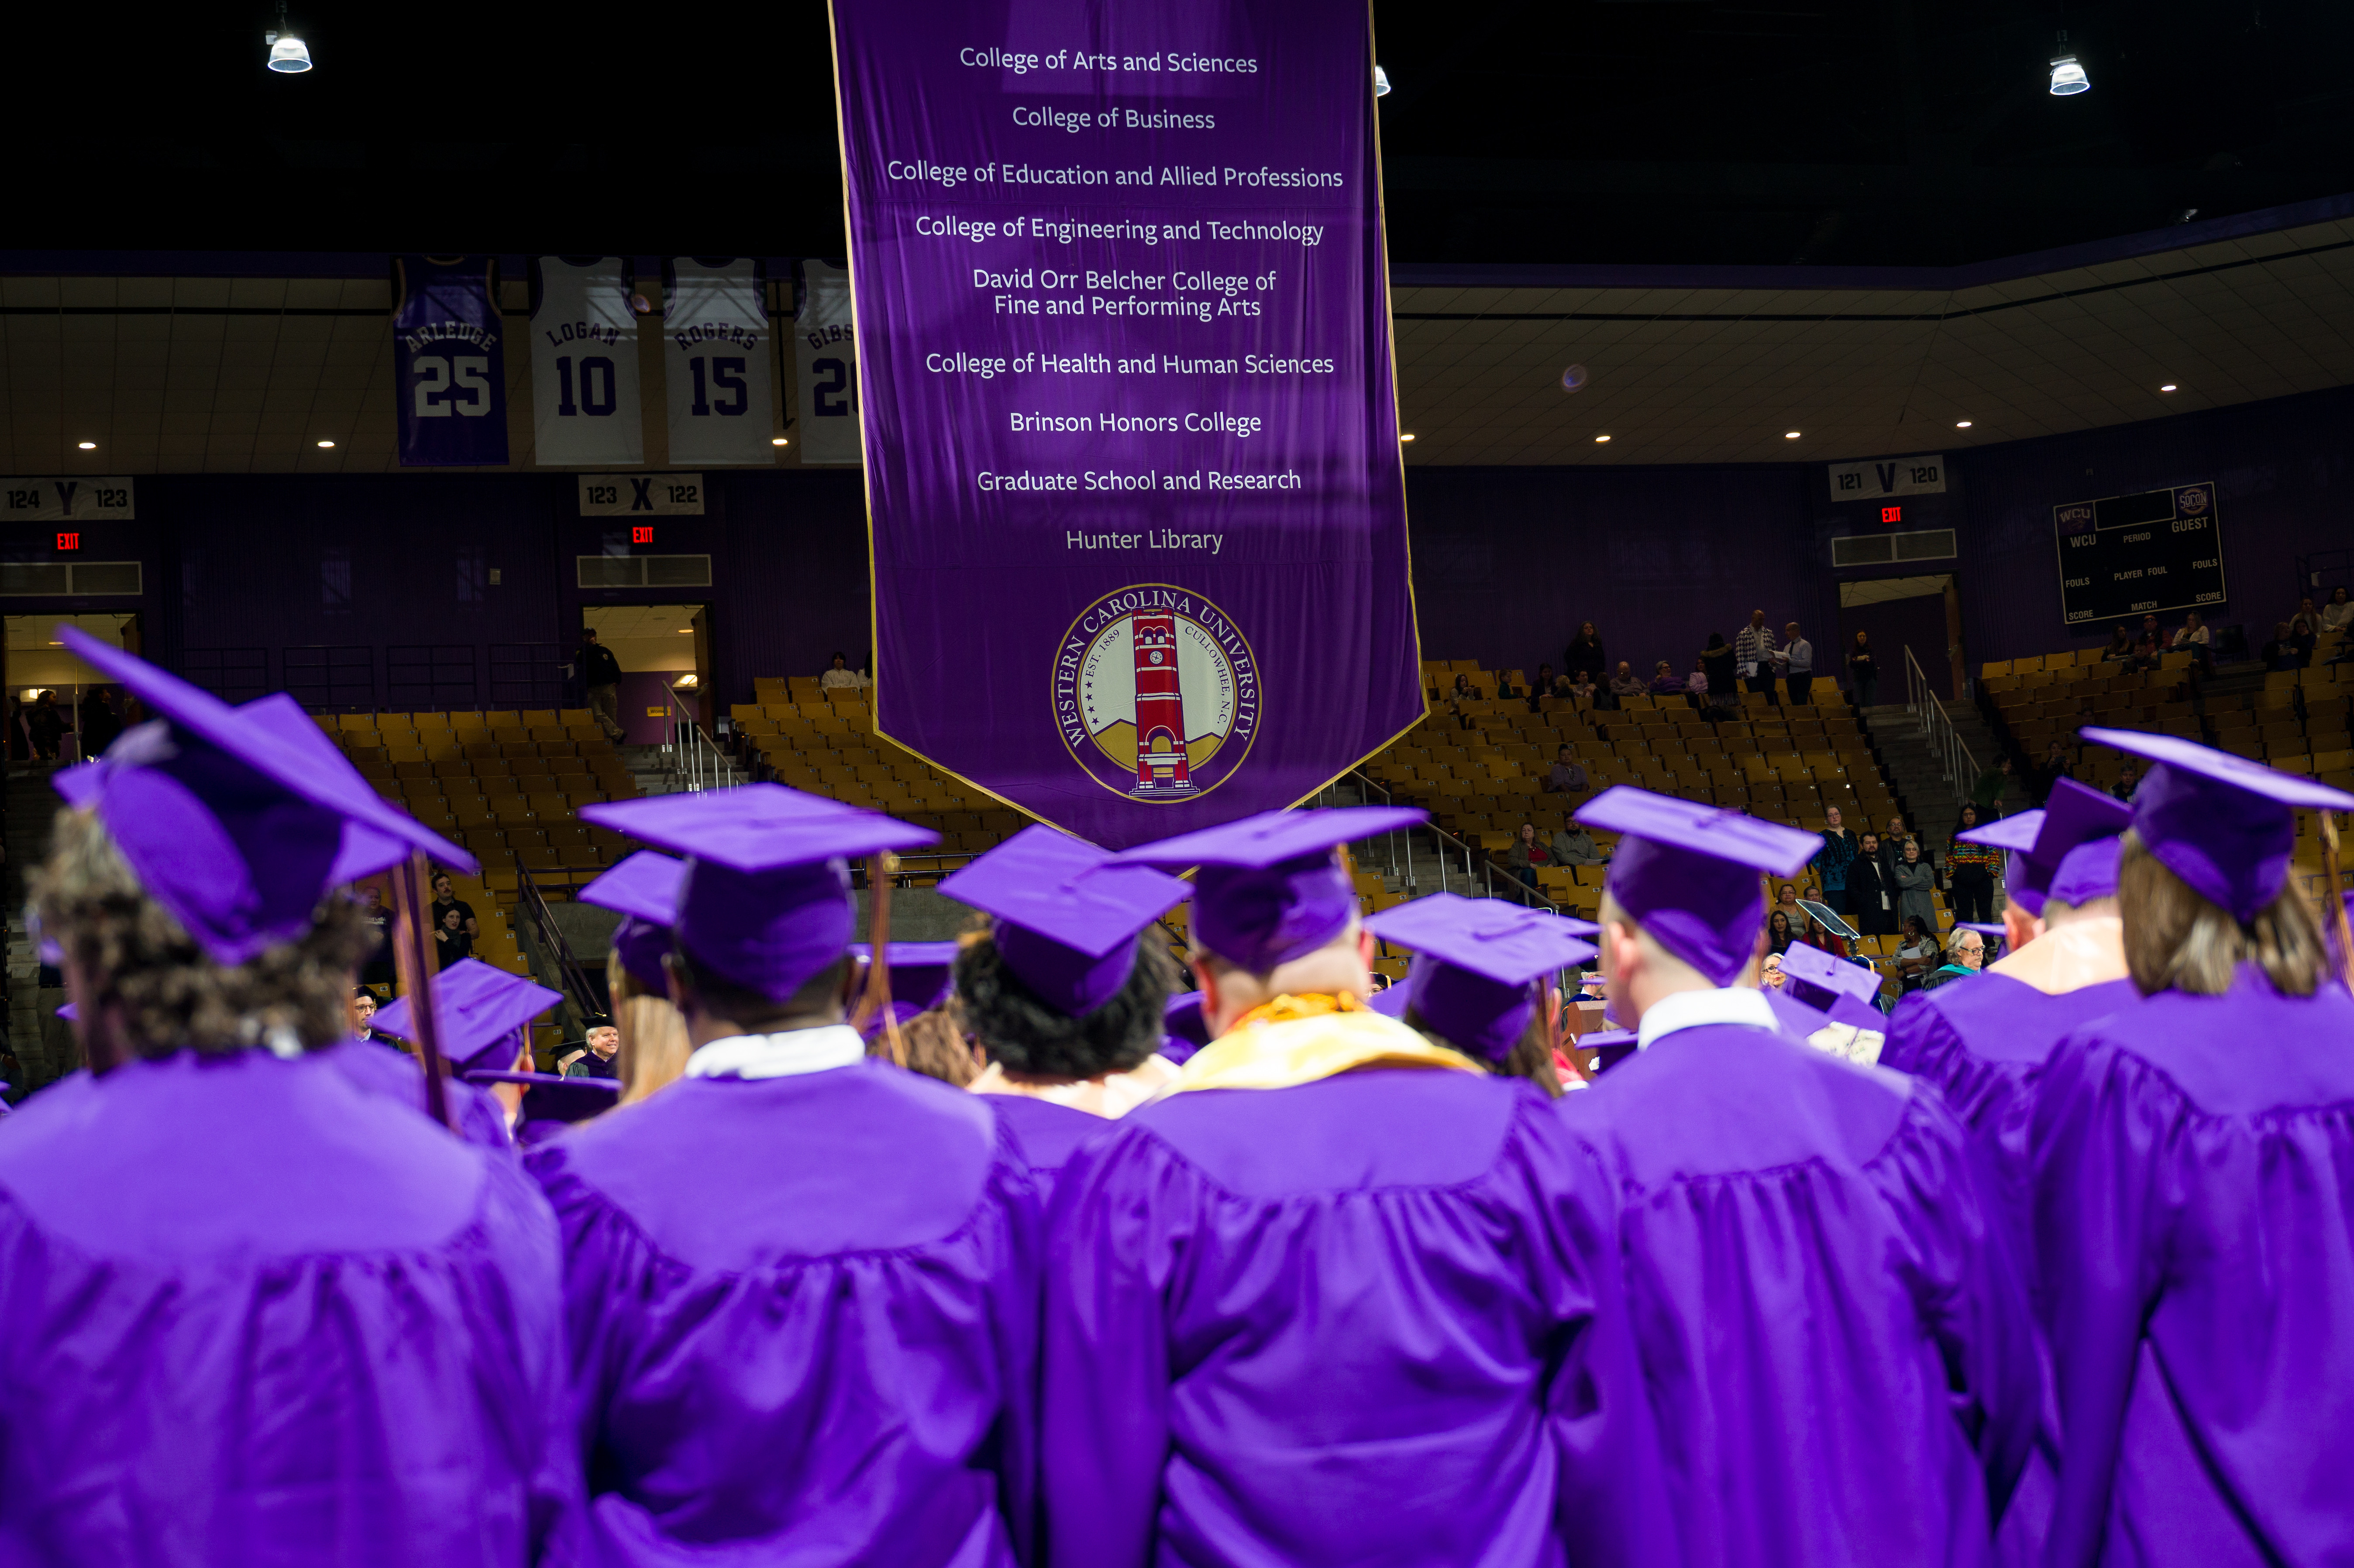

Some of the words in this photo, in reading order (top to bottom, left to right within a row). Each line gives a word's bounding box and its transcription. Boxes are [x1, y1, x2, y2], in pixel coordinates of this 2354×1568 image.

[960, 47, 1038, 74] College
[1045, 49, 1067, 69] of
[1073, 51, 1117, 70] Arts
[1123, 52, 1160, 71] and
[1167, 52, 1257, 73] Sciences
[1013, 107, 1091, 133] College
[1098, 107, 1119, 127] of
[1125, 109, 1215, 129] Business
[888, 160, 967, 187] College
[974, 162, 995, 182] of
[1002, 163, 1108, 185] Education
[1115, 165, 1153, 186] and
[1160, 166, 1217, 186] Allied
[1224, 166, 1343, 187] Professions
[916, 215, 996, 243] College
[1003, 216, 1025, 237] of
[1032, 218, 1158, 245] Engineering
[1163, 220, 1200, 240] and
[1206, 220, 1324, 246] Technology
[974, 268, 1033, 289] David
[1040, 269, 1079, 289] Orr
[1086, 269, 1166, 290] Belcher
[1173, 271, 1249, 295] College
[1256, 270, 1276, 291] of
[995, 294, 1039, 315] Fine
[1046, 295, 1084, 315] and
[1092, 295, 1212, 322] Performing
[1217, 298, 1261, 316] Arts
[404, 320, 498, 354] ARLEDGE
[546, 321, 620, 348] LOGAN
[673, 321, 758, 351] ROGERS
[926, 352, 1006, 379] College
[1012, 352, 1035, 373] of
[1041, 353, 1111, 373] Health
[1118, 353, 1156, 374] and
[1163, 355, 1238, 374] Human
[1245, 354, 1334, 374] Sciences
[413, 355, 491, 417] 25
[556, 356, 617, 416] 10
[688, 356, 748, 416] 15
[1010, 411, 1092, 432] Brinson
[1100, 413, 1178, 432] Honors
[1184, 411, 1261, 438] College
[977, 470, 1077, 491] Graduate
[1084, 470, 1156, 490] School
[1163, 470, 1201, 490] and
[1208, 469, 1301, 490] Research
[1837, 473, 1862, 490] 121
[1876, 463, 1896, 493] V
[1910, 466, 1938, 484] 120
[7, 490, 40, 509] 124
[55, 481, 78, 516] Y
[95, 489, 128, 508] 123
[586, 486, 617, 504] 123
[630, 478, 654, 511] X
[667, 485, 698, 503] 122
[1882, 506, 1901, 523] EXIT
[2059, 507, 2091, 523] WCU
[2172, 516, 2208, 533] GUEST
[57, 533, 79, 550] EXIT
[633, 526, 653, 543] EXIT
[1067, 530, 1142, 549] Hunter
[1149, 529, 1223, 554] Library
[2070, 533, 2097, 548] WCU
[2123, 532, 2151, 543] PERIOD
[2114, 569, 2143, 581] PLAYER
[2148, 566, 2168, 576] FOUL
[2192, 558, 2218, 570] FOULS
[2065, 577, 2090, 588] FOULS
[2131, 600, 2158, 612] MATCH
[2196, 591, 2222, 603] SCORE
[2068, 609, 2094, 621] SCORE
[1085, 653, 1101, 678] EST.
[1098, 629, 1120, 651] 1889
[1058, 634, 1086, 748] WESTERN
[1083, 590, 1192, 633] CAROLINA
[1199, 605, 1256, 741] UNIVERSITY
[1184, 626, 1231, 696] CULLOWHEE,
[1216, 700, 1230, 725] N.C.
